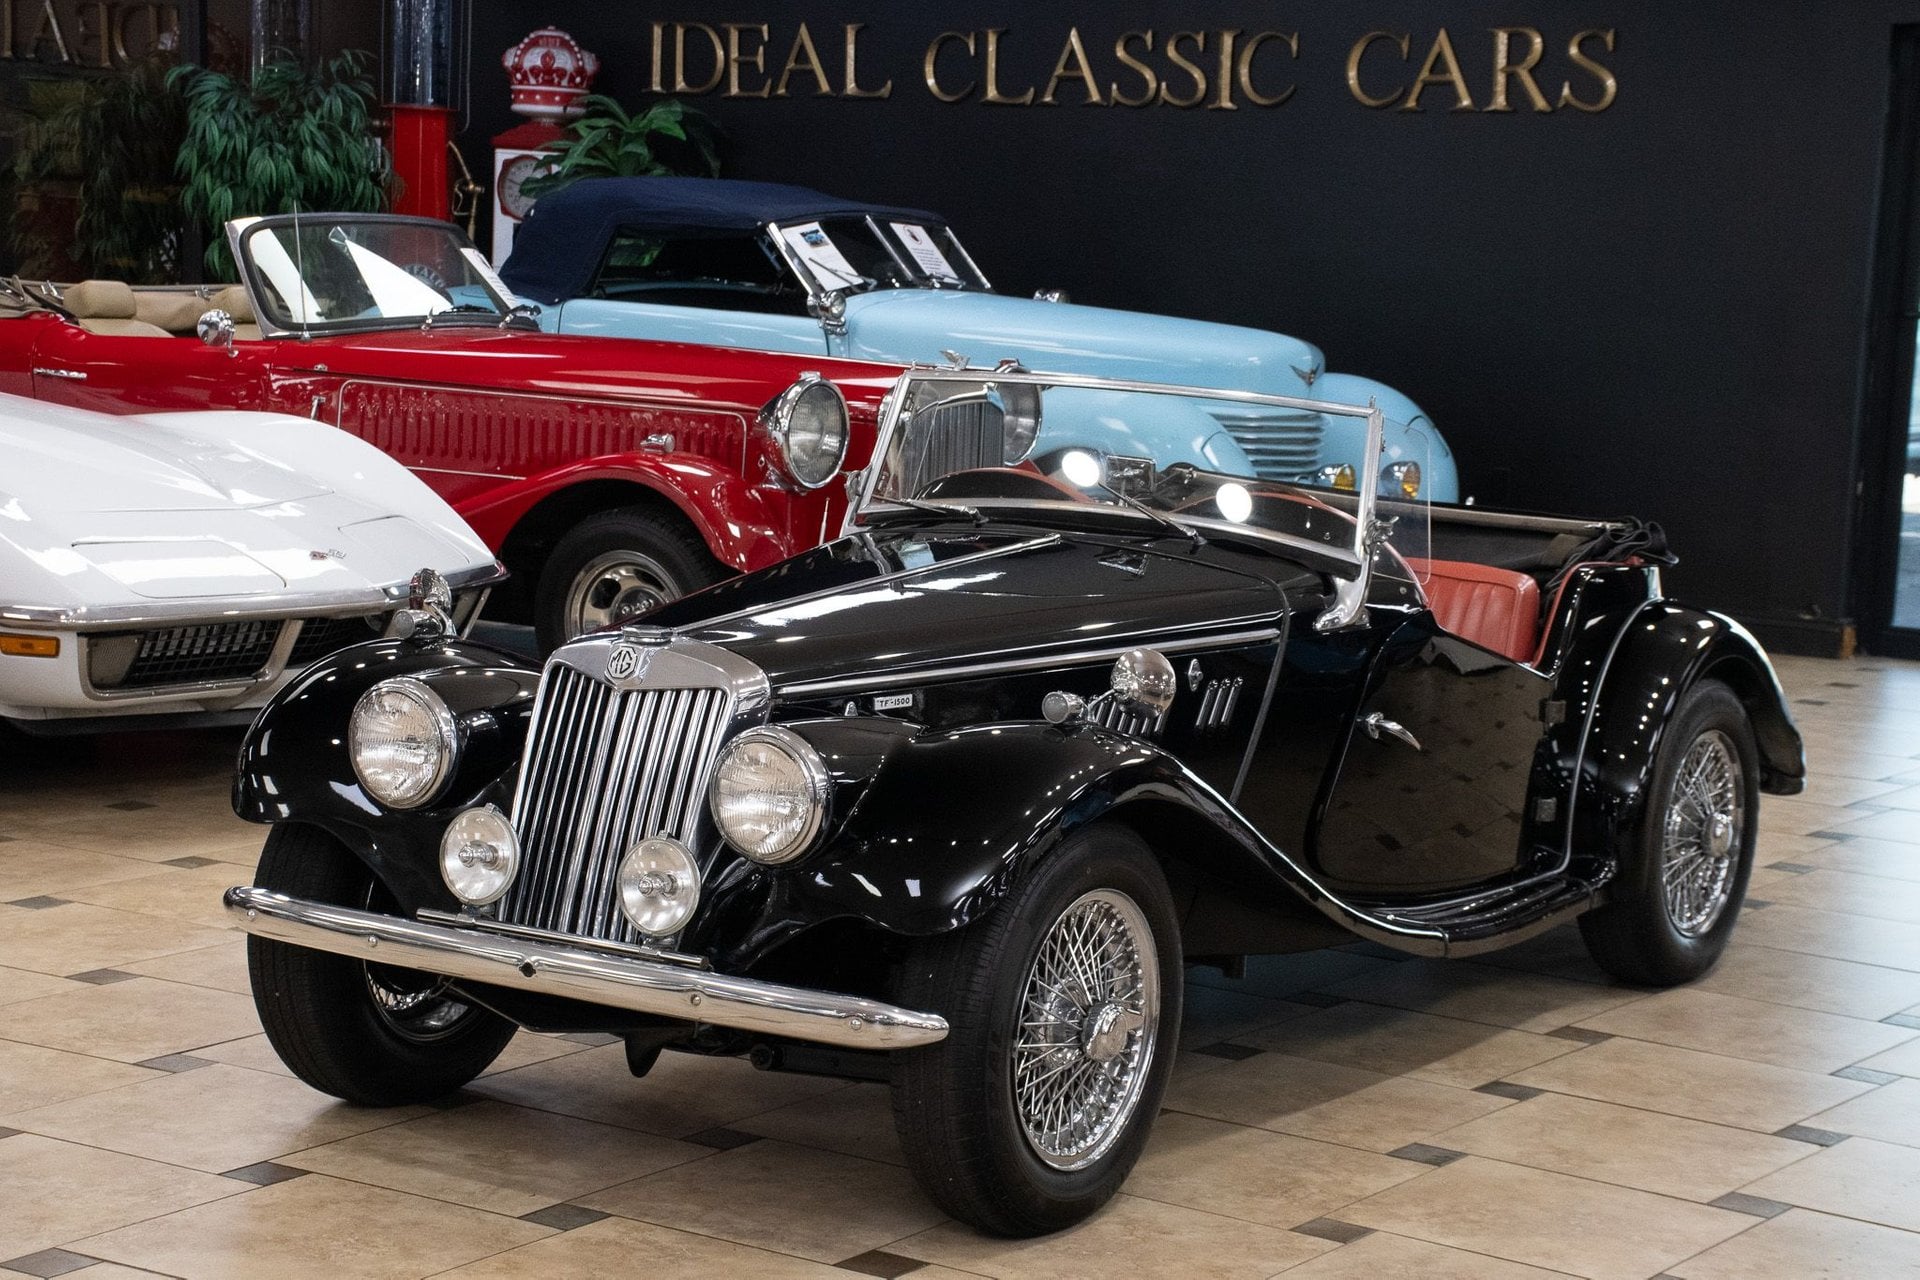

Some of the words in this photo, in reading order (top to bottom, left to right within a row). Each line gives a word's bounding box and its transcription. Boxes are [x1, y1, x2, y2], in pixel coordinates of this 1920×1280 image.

[642, 22, 892, 98] IDEAL
[923, 27, 1298, 110] CLASSIC
[1346, 28, 1618, 112] CARS
[610, 649, 633, 675] MG
